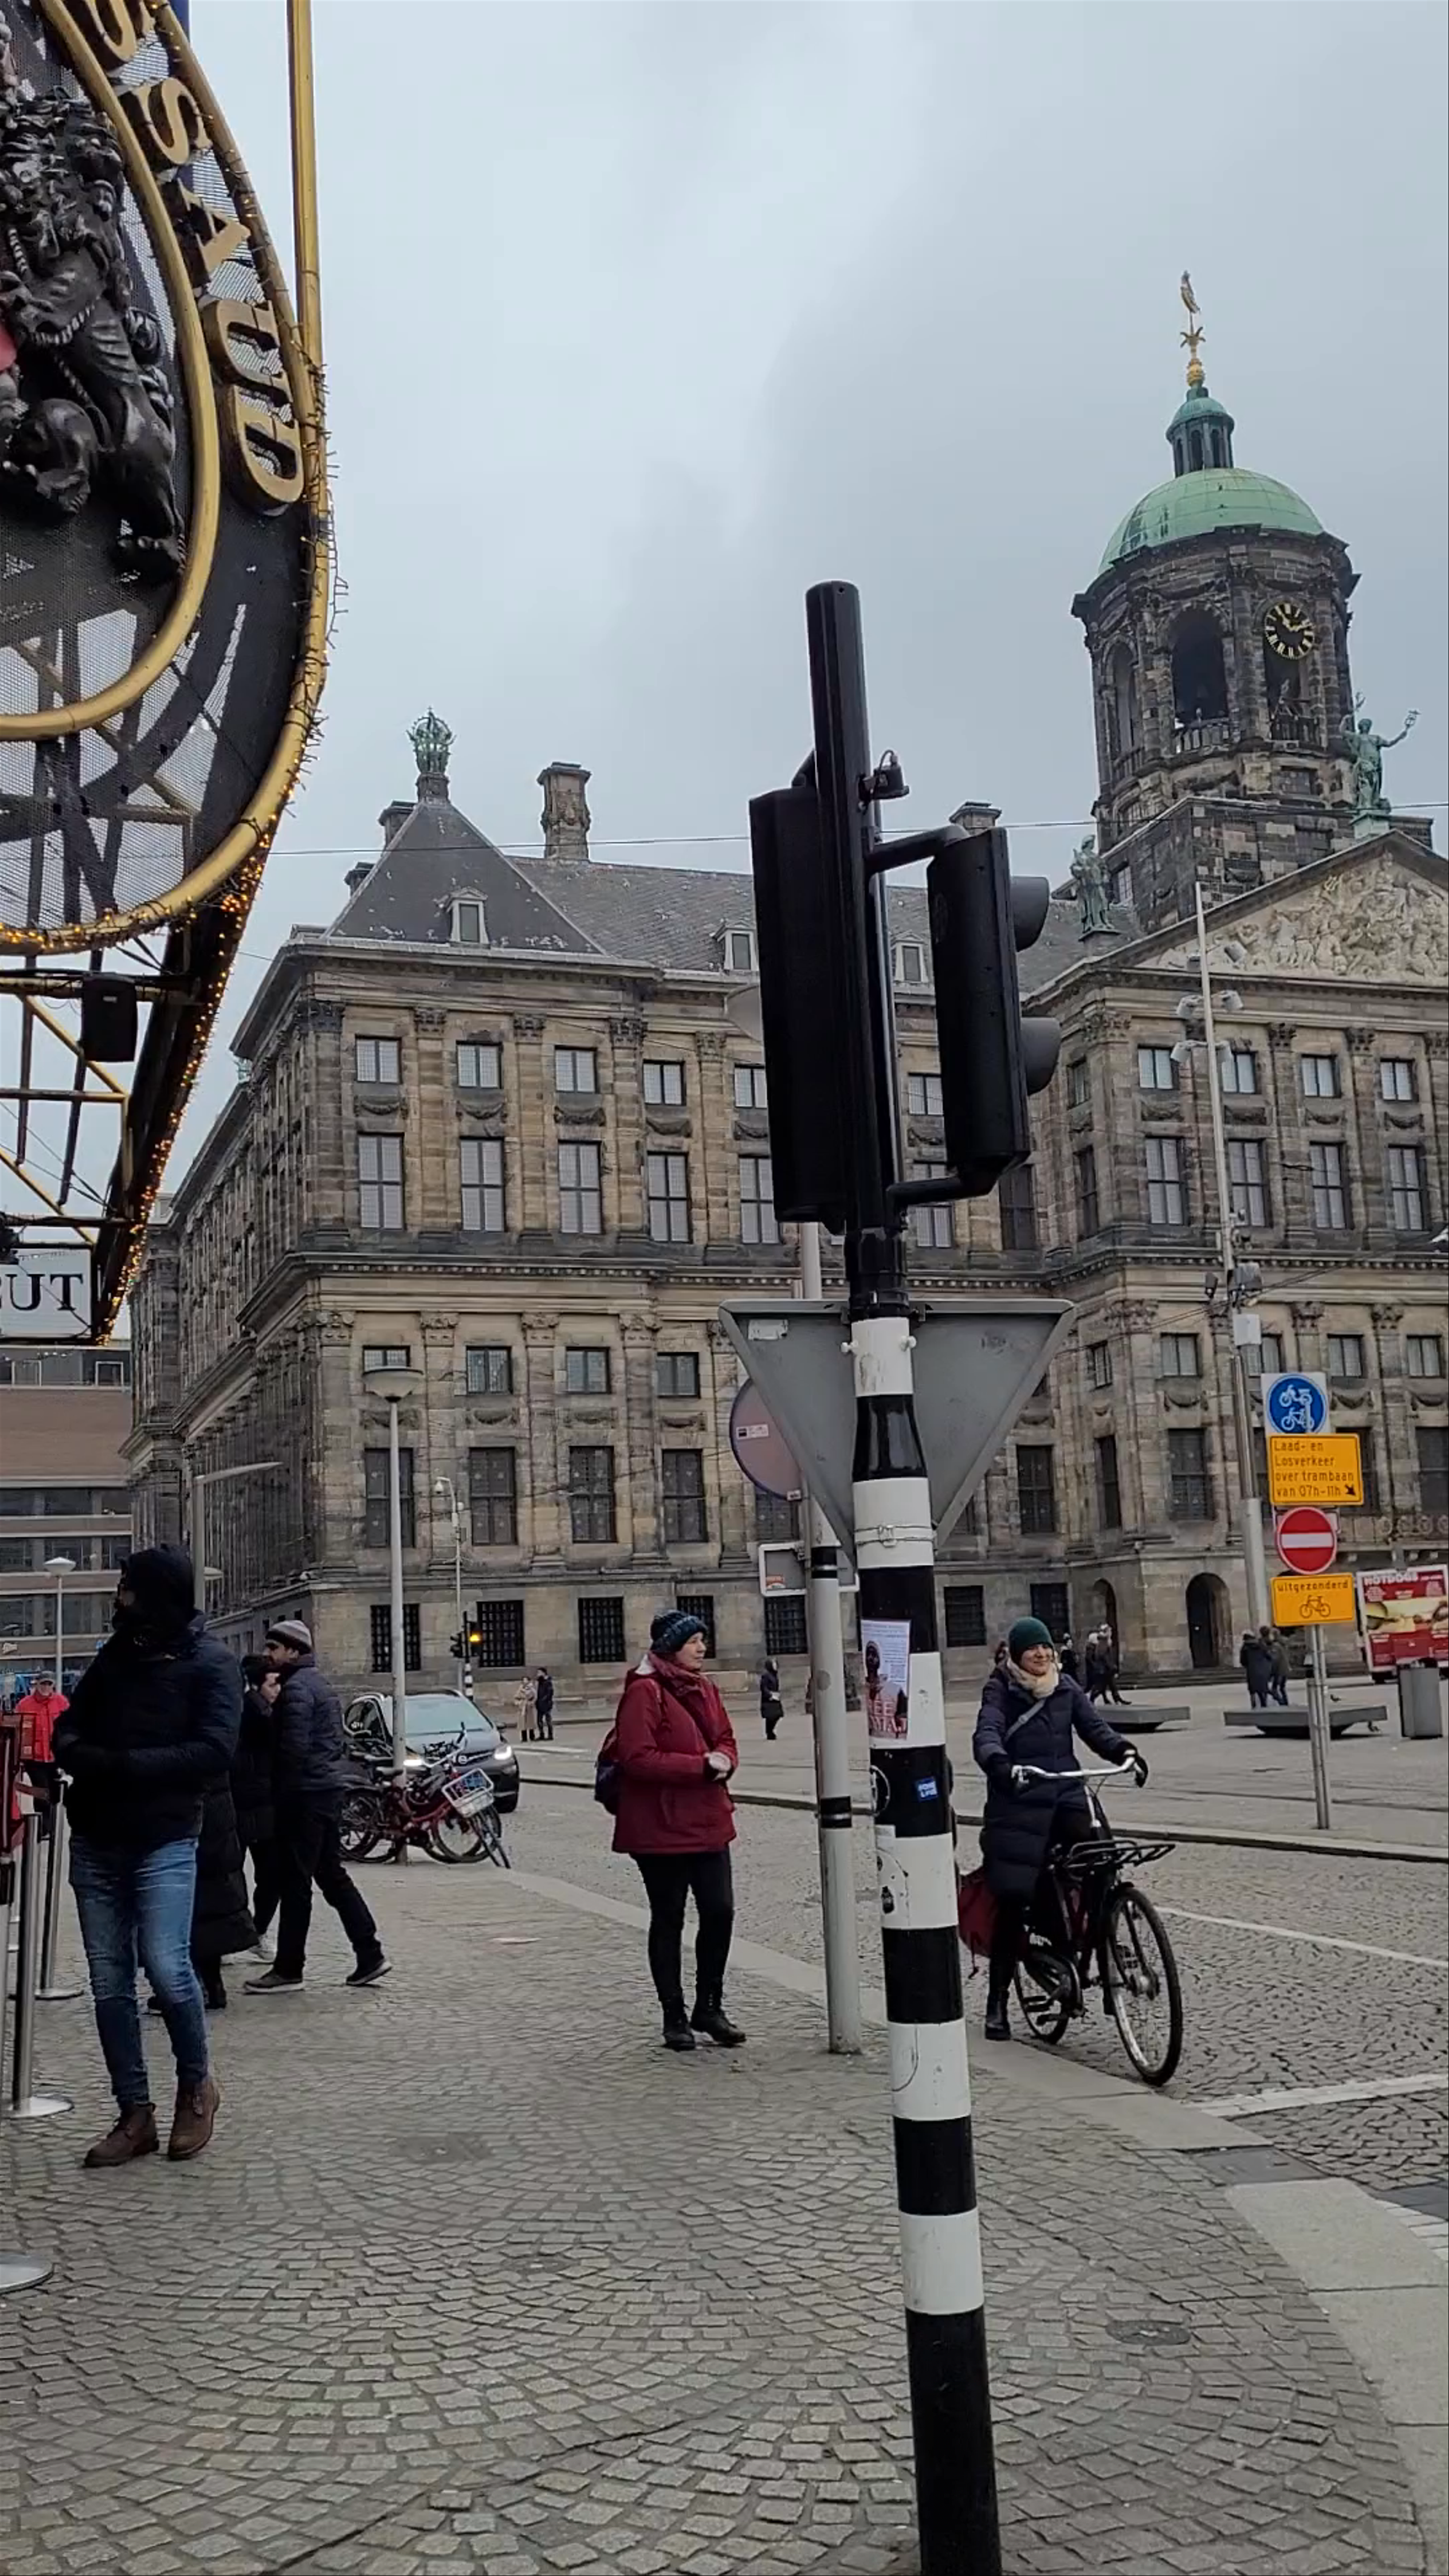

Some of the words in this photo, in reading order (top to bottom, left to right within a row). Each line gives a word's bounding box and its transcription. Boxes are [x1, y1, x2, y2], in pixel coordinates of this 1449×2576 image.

[0, 1274, 83, 1311] UT
[1274, 1439, 1305, 1451] Laad-
[1311, 1442, 1324, 1451] en
[1275, 1455, 1335, 1467] Losverkeer
[1275, 1472, 1299, 1481] over
[1303, 1470, 1354, 1481] trambaan
[1277, 1487, 1296, 1497] van
[1277, 1579, 1348, 1593] uitgezonderd
